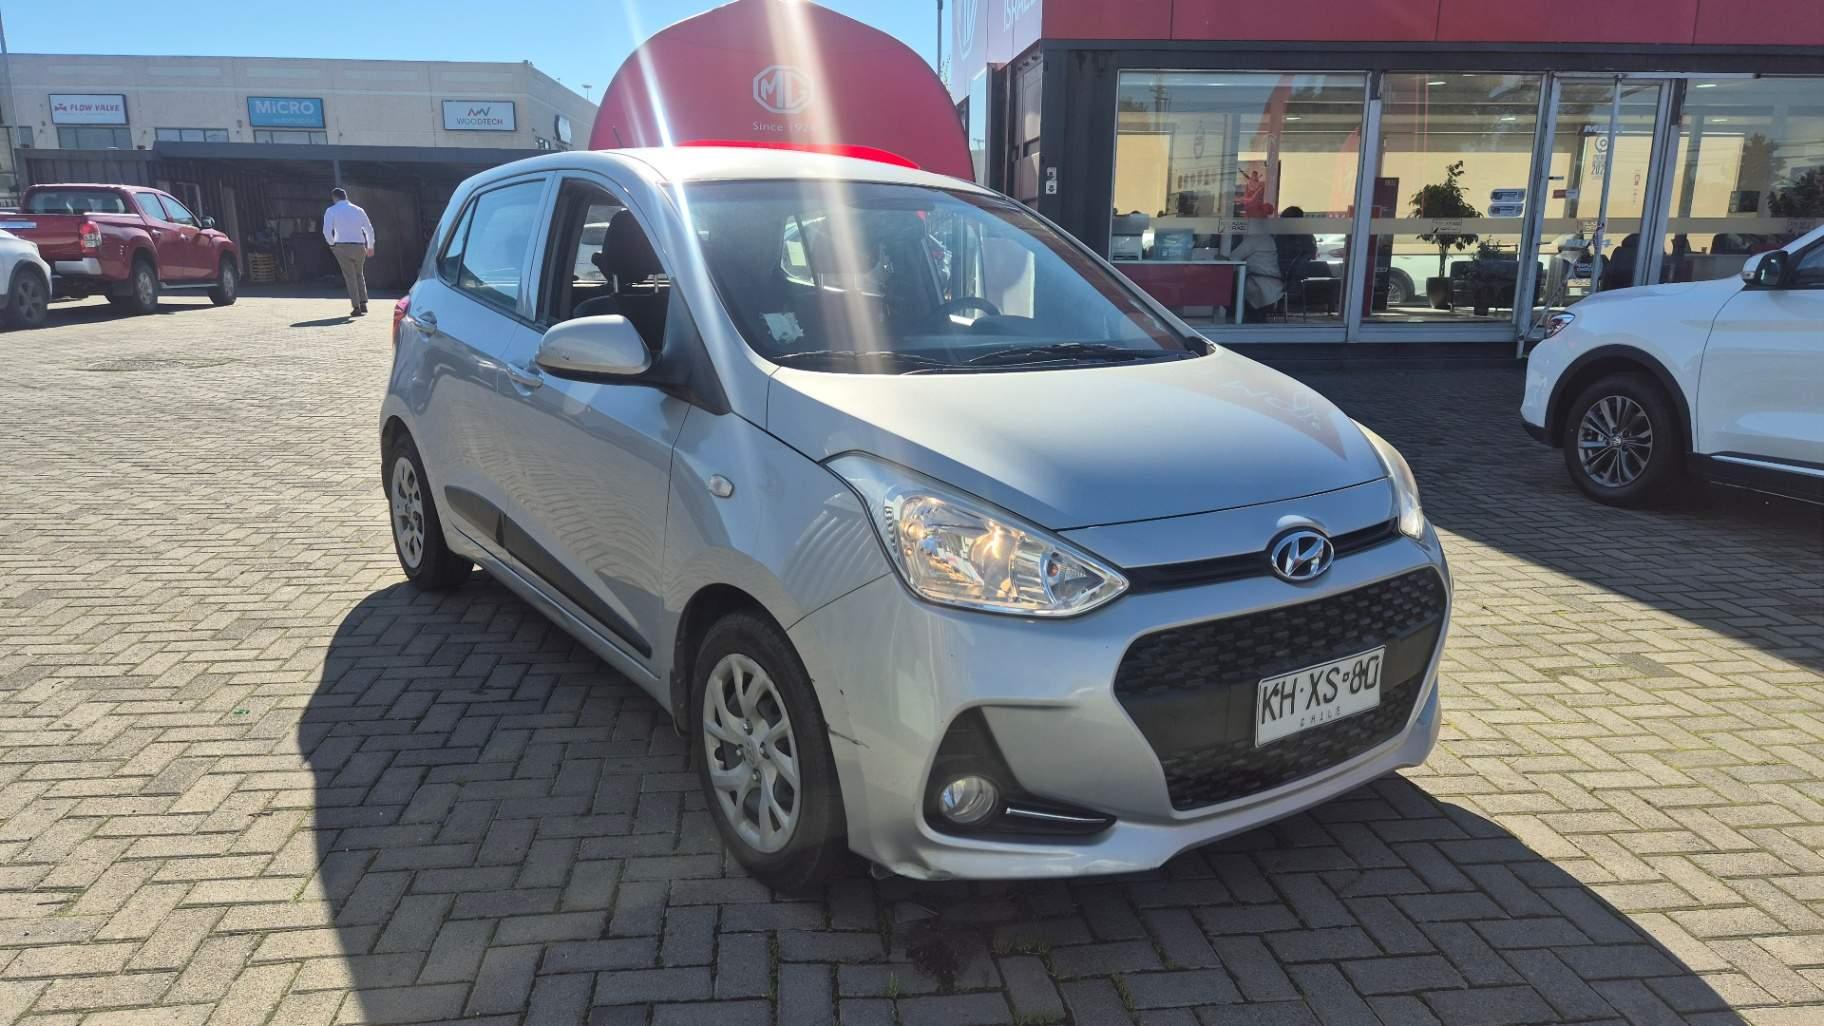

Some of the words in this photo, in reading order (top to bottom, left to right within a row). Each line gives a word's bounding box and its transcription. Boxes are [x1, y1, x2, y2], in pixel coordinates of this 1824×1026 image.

[758, 69, 813, 110] MG
[95, 104, 120, 112] VALVE
[457, 118, 503, 126] WOODTECH
[752, 120, 784, 132] Since
[1300, 706, 1341, 728] CHILE
